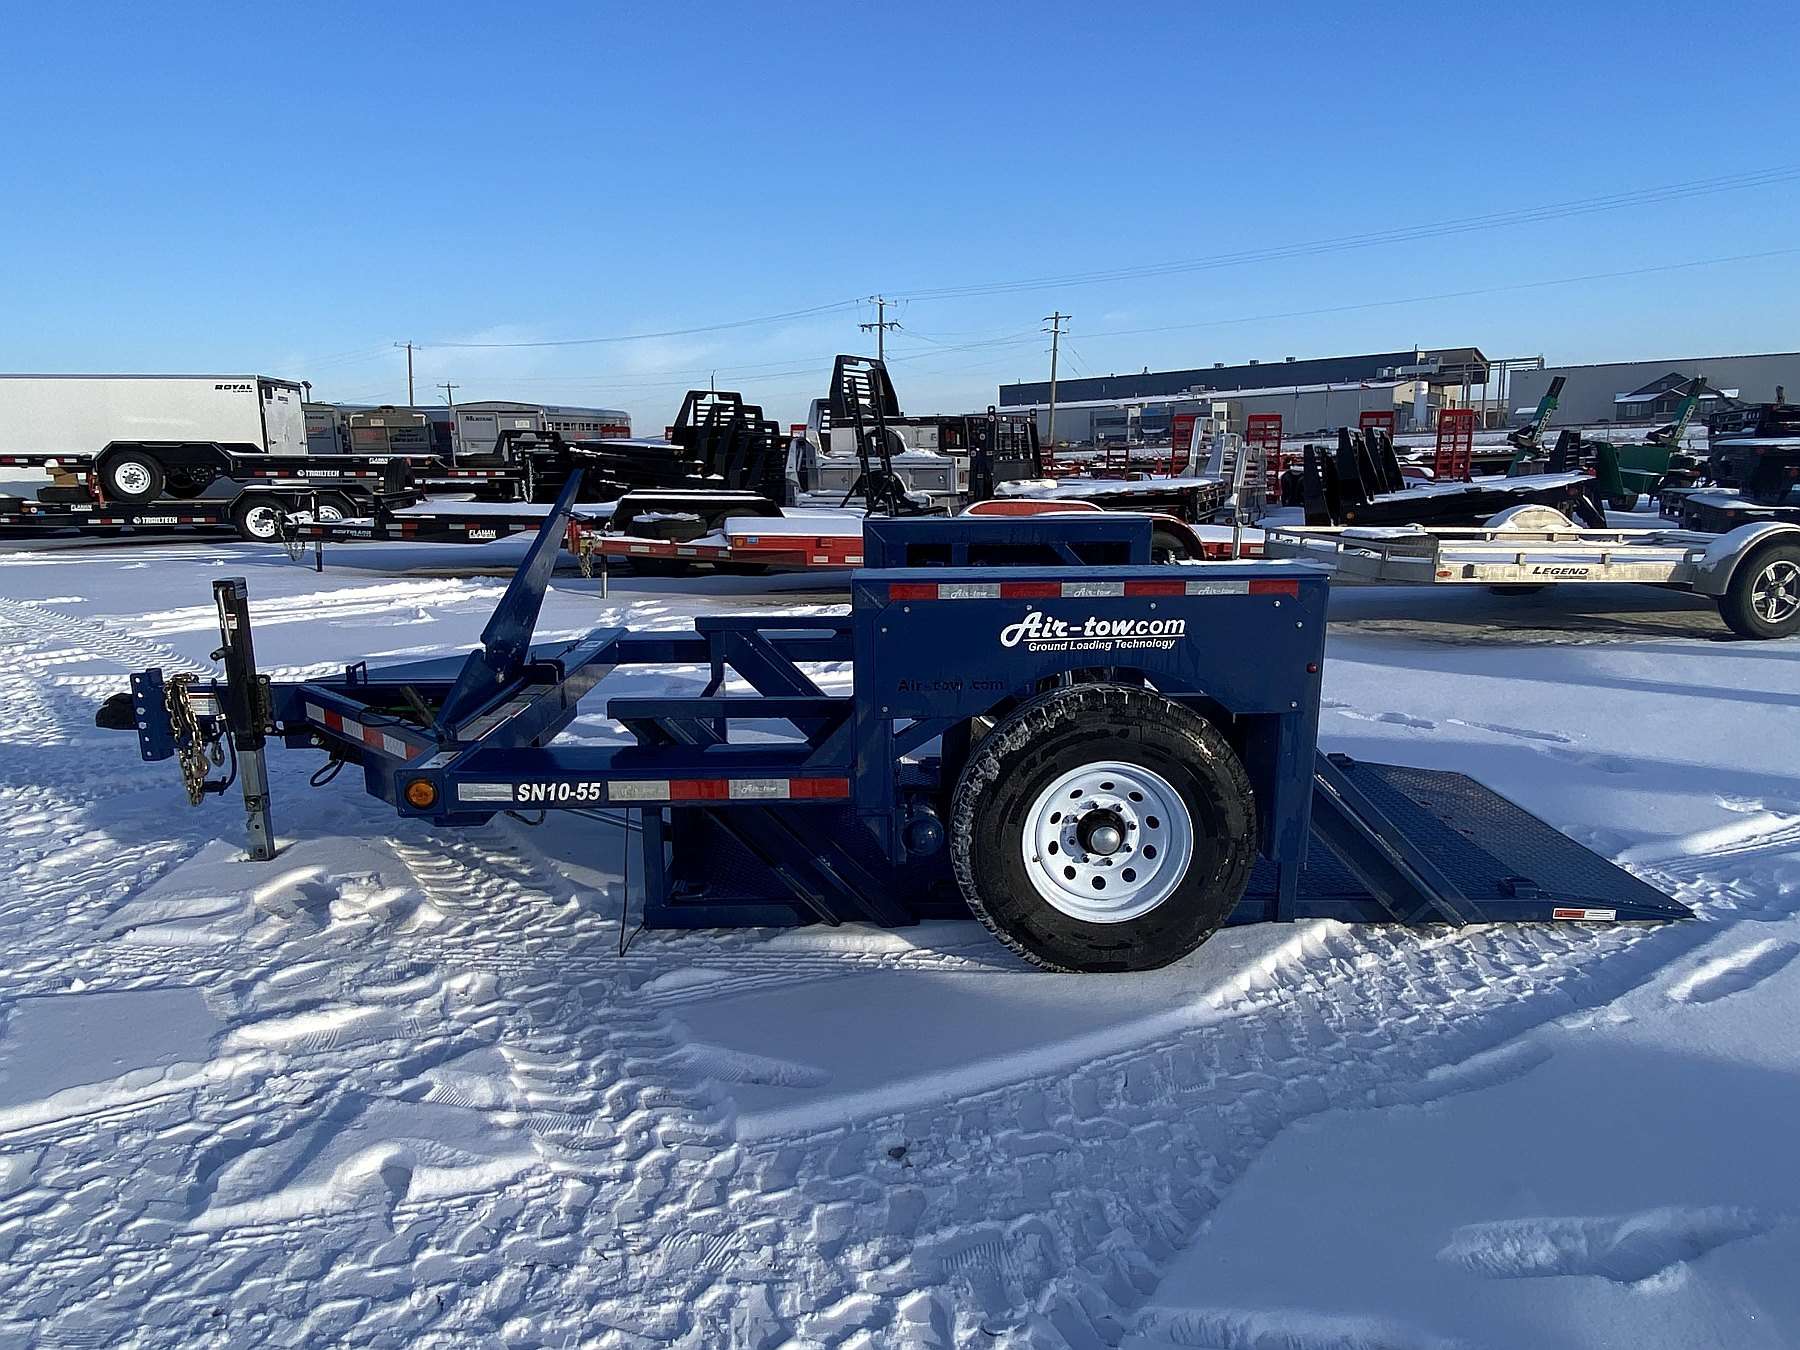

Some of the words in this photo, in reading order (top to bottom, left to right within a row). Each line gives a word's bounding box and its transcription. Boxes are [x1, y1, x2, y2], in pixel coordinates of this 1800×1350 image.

[141, 516, 178, 524] TRAILTECH
[1000, 611, 1186, 648] Air-tow.com
[1028, 642, 1068, 652] Ground
[1069, 640, 1113, 651] Loading
[1115, 639, 1177, 650] Technology
[517, 782, 601, 802] SN10-55
